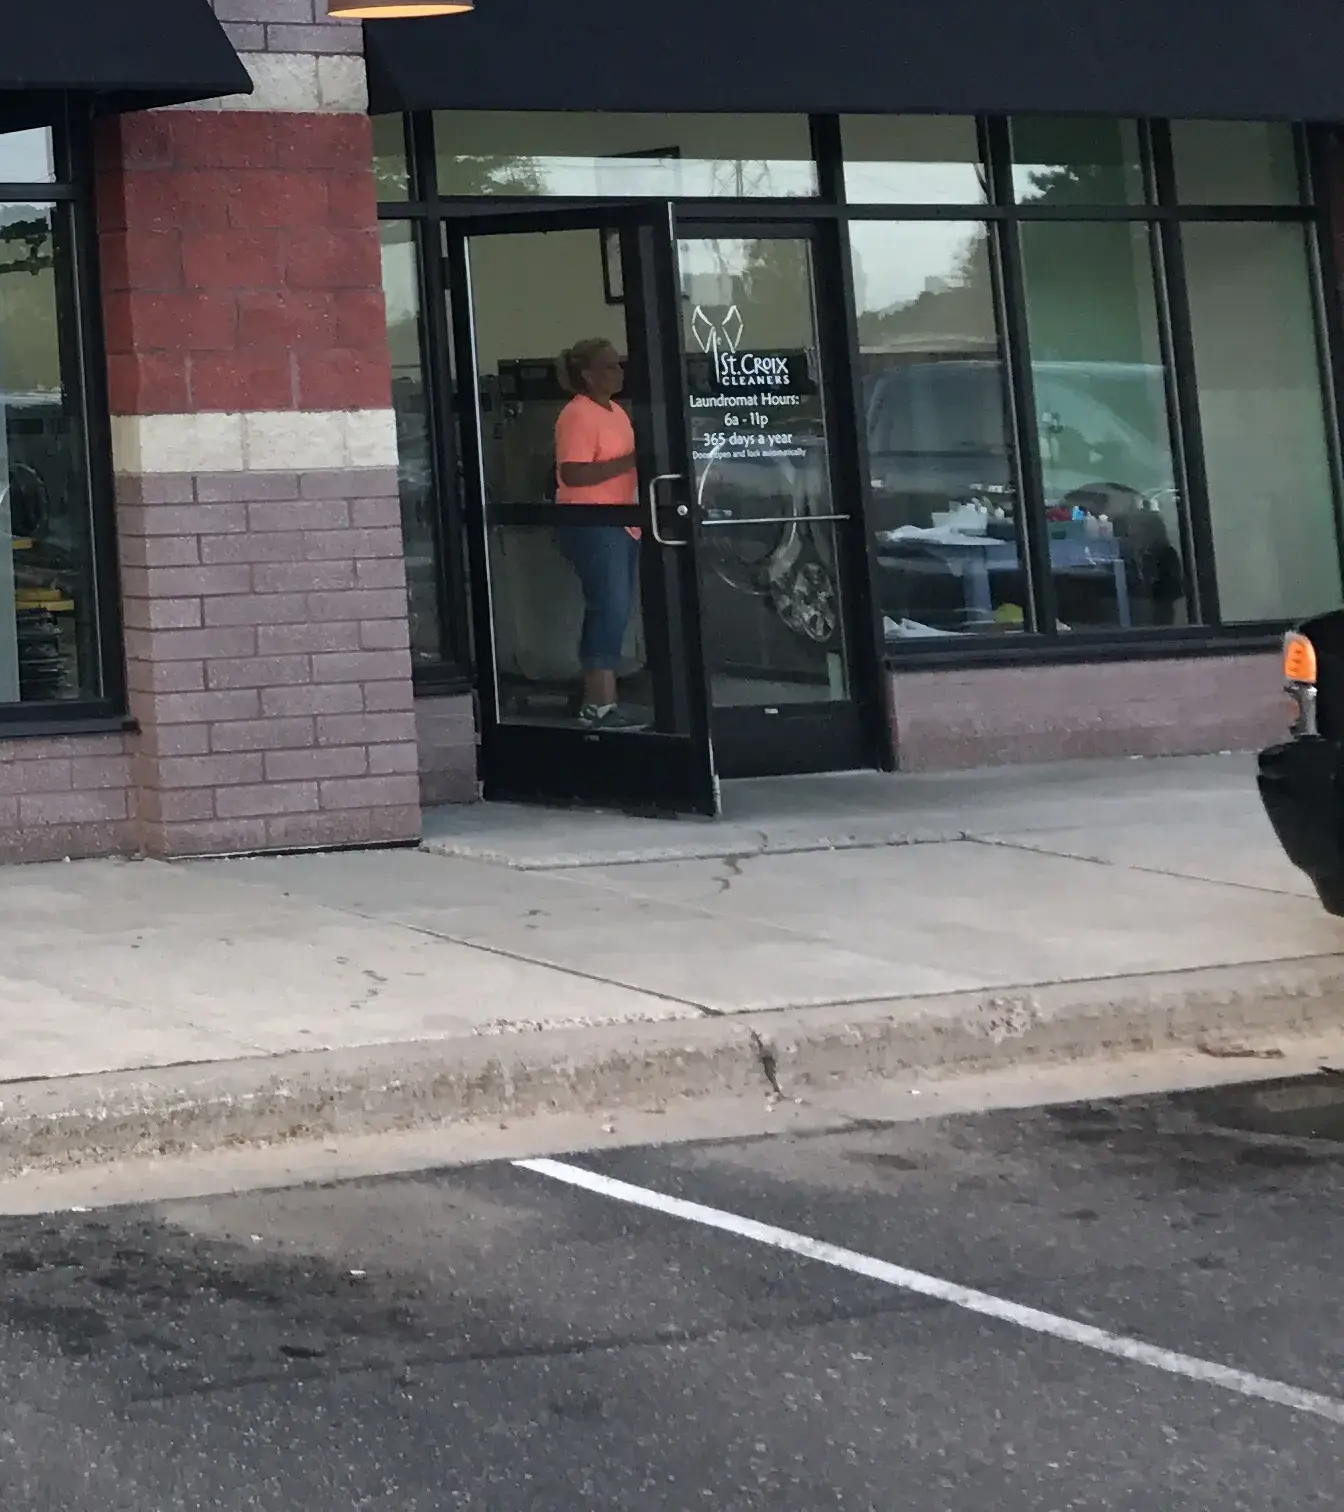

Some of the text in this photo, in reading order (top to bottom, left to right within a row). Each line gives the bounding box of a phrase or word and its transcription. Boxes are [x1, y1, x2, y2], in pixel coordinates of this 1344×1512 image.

[720, 352, 741, 376] St.
[721, 375, 791, 386] CLEANERS
[689, 392, 800, 408] Laundromat Hours:
[724, 412, 739, 426] 6a
[749, 412, 769, 428] 11p
[703, 431, 793, 448] 365 days a year
